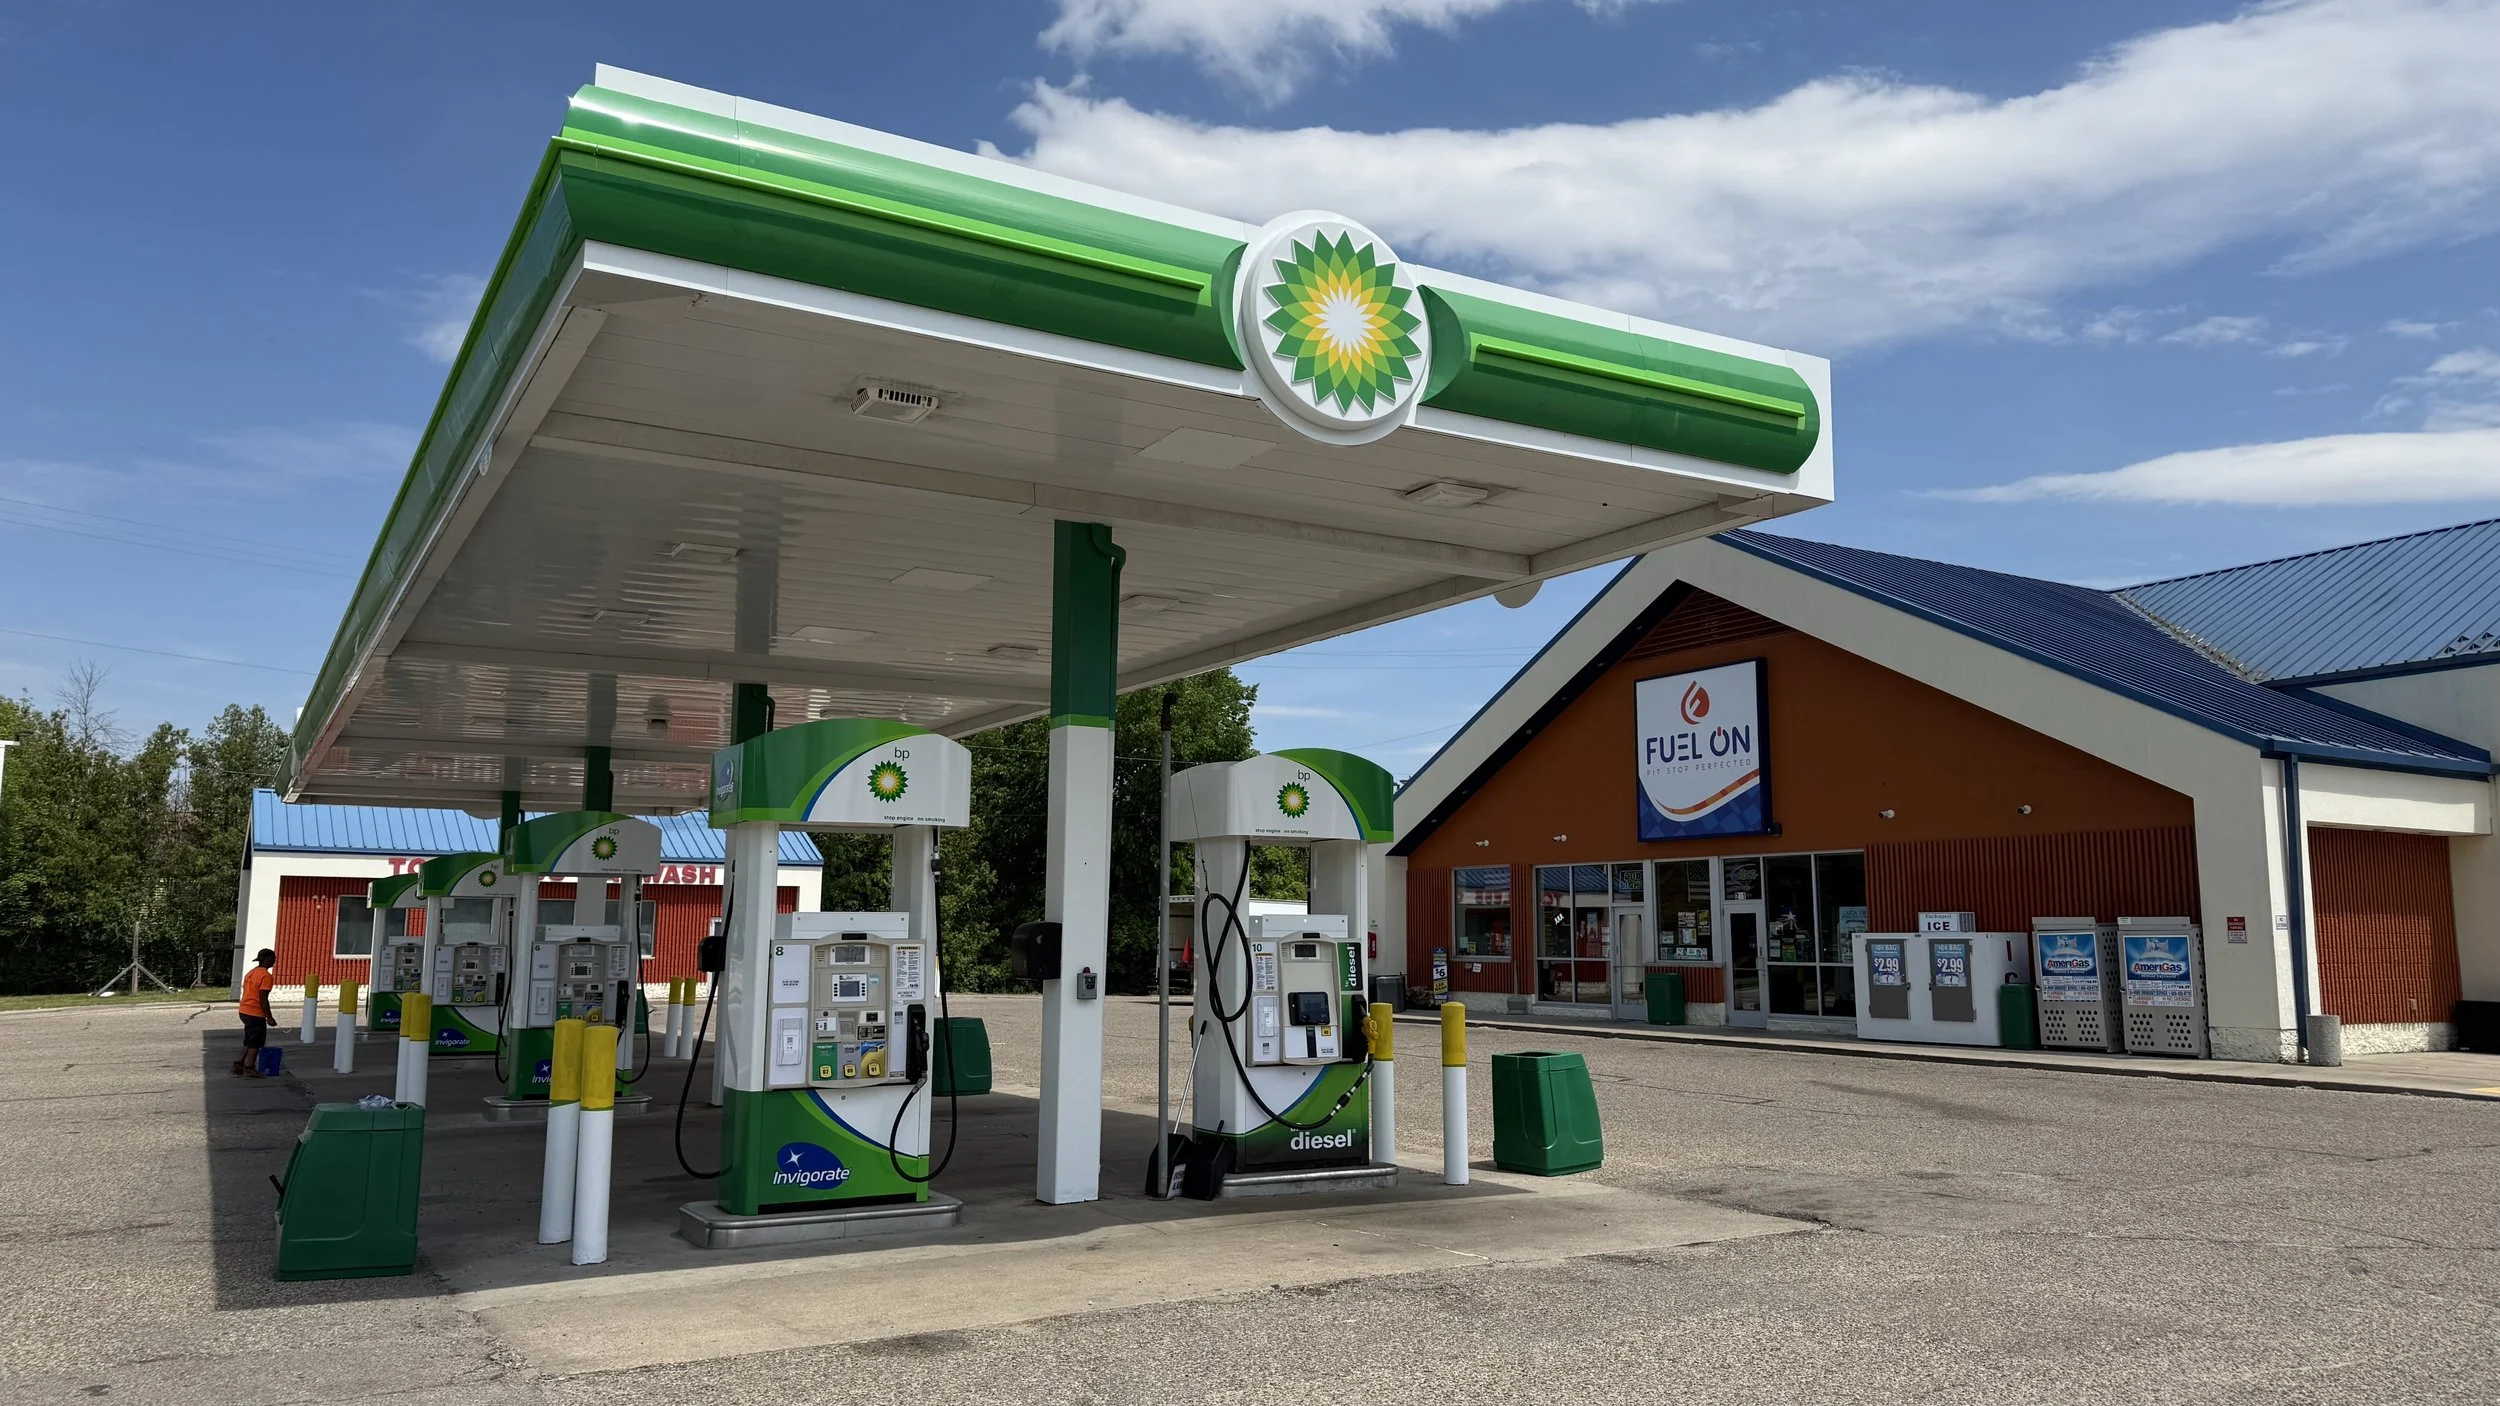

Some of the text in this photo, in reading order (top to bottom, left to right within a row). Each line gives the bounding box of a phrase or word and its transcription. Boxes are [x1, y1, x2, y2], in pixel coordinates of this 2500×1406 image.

[1646, 725, 1750, 765] FUEL ON
[894, 746, 910, 761] bp
[1647, 758, 1752, 776] PIT STOP PERFECTED
[1297, 769, 1311, 782] bp
[608, 826, 620, 836] bp
[1927, 921, 1951, 931] ICE
[775, 946, 784, 956] 8
[1252, 943, 1262, 952] 10
[1346, 946, 1357, 987] diesel
[1874, 958, 1899, 972] $2.99
[1937, 958, 1964, 973] $2.99
[2047, 959, 2090, 969] AmeriGas
[2133, 963, 2183, 973] AmeriGas
[1435, 968, 1446, 977] $6
[435, 1039, 470, 1047] Invigorate
[1290, 1128, 1352, 1150] diesel
[772, 1167, 850, 1187] Invigorate
